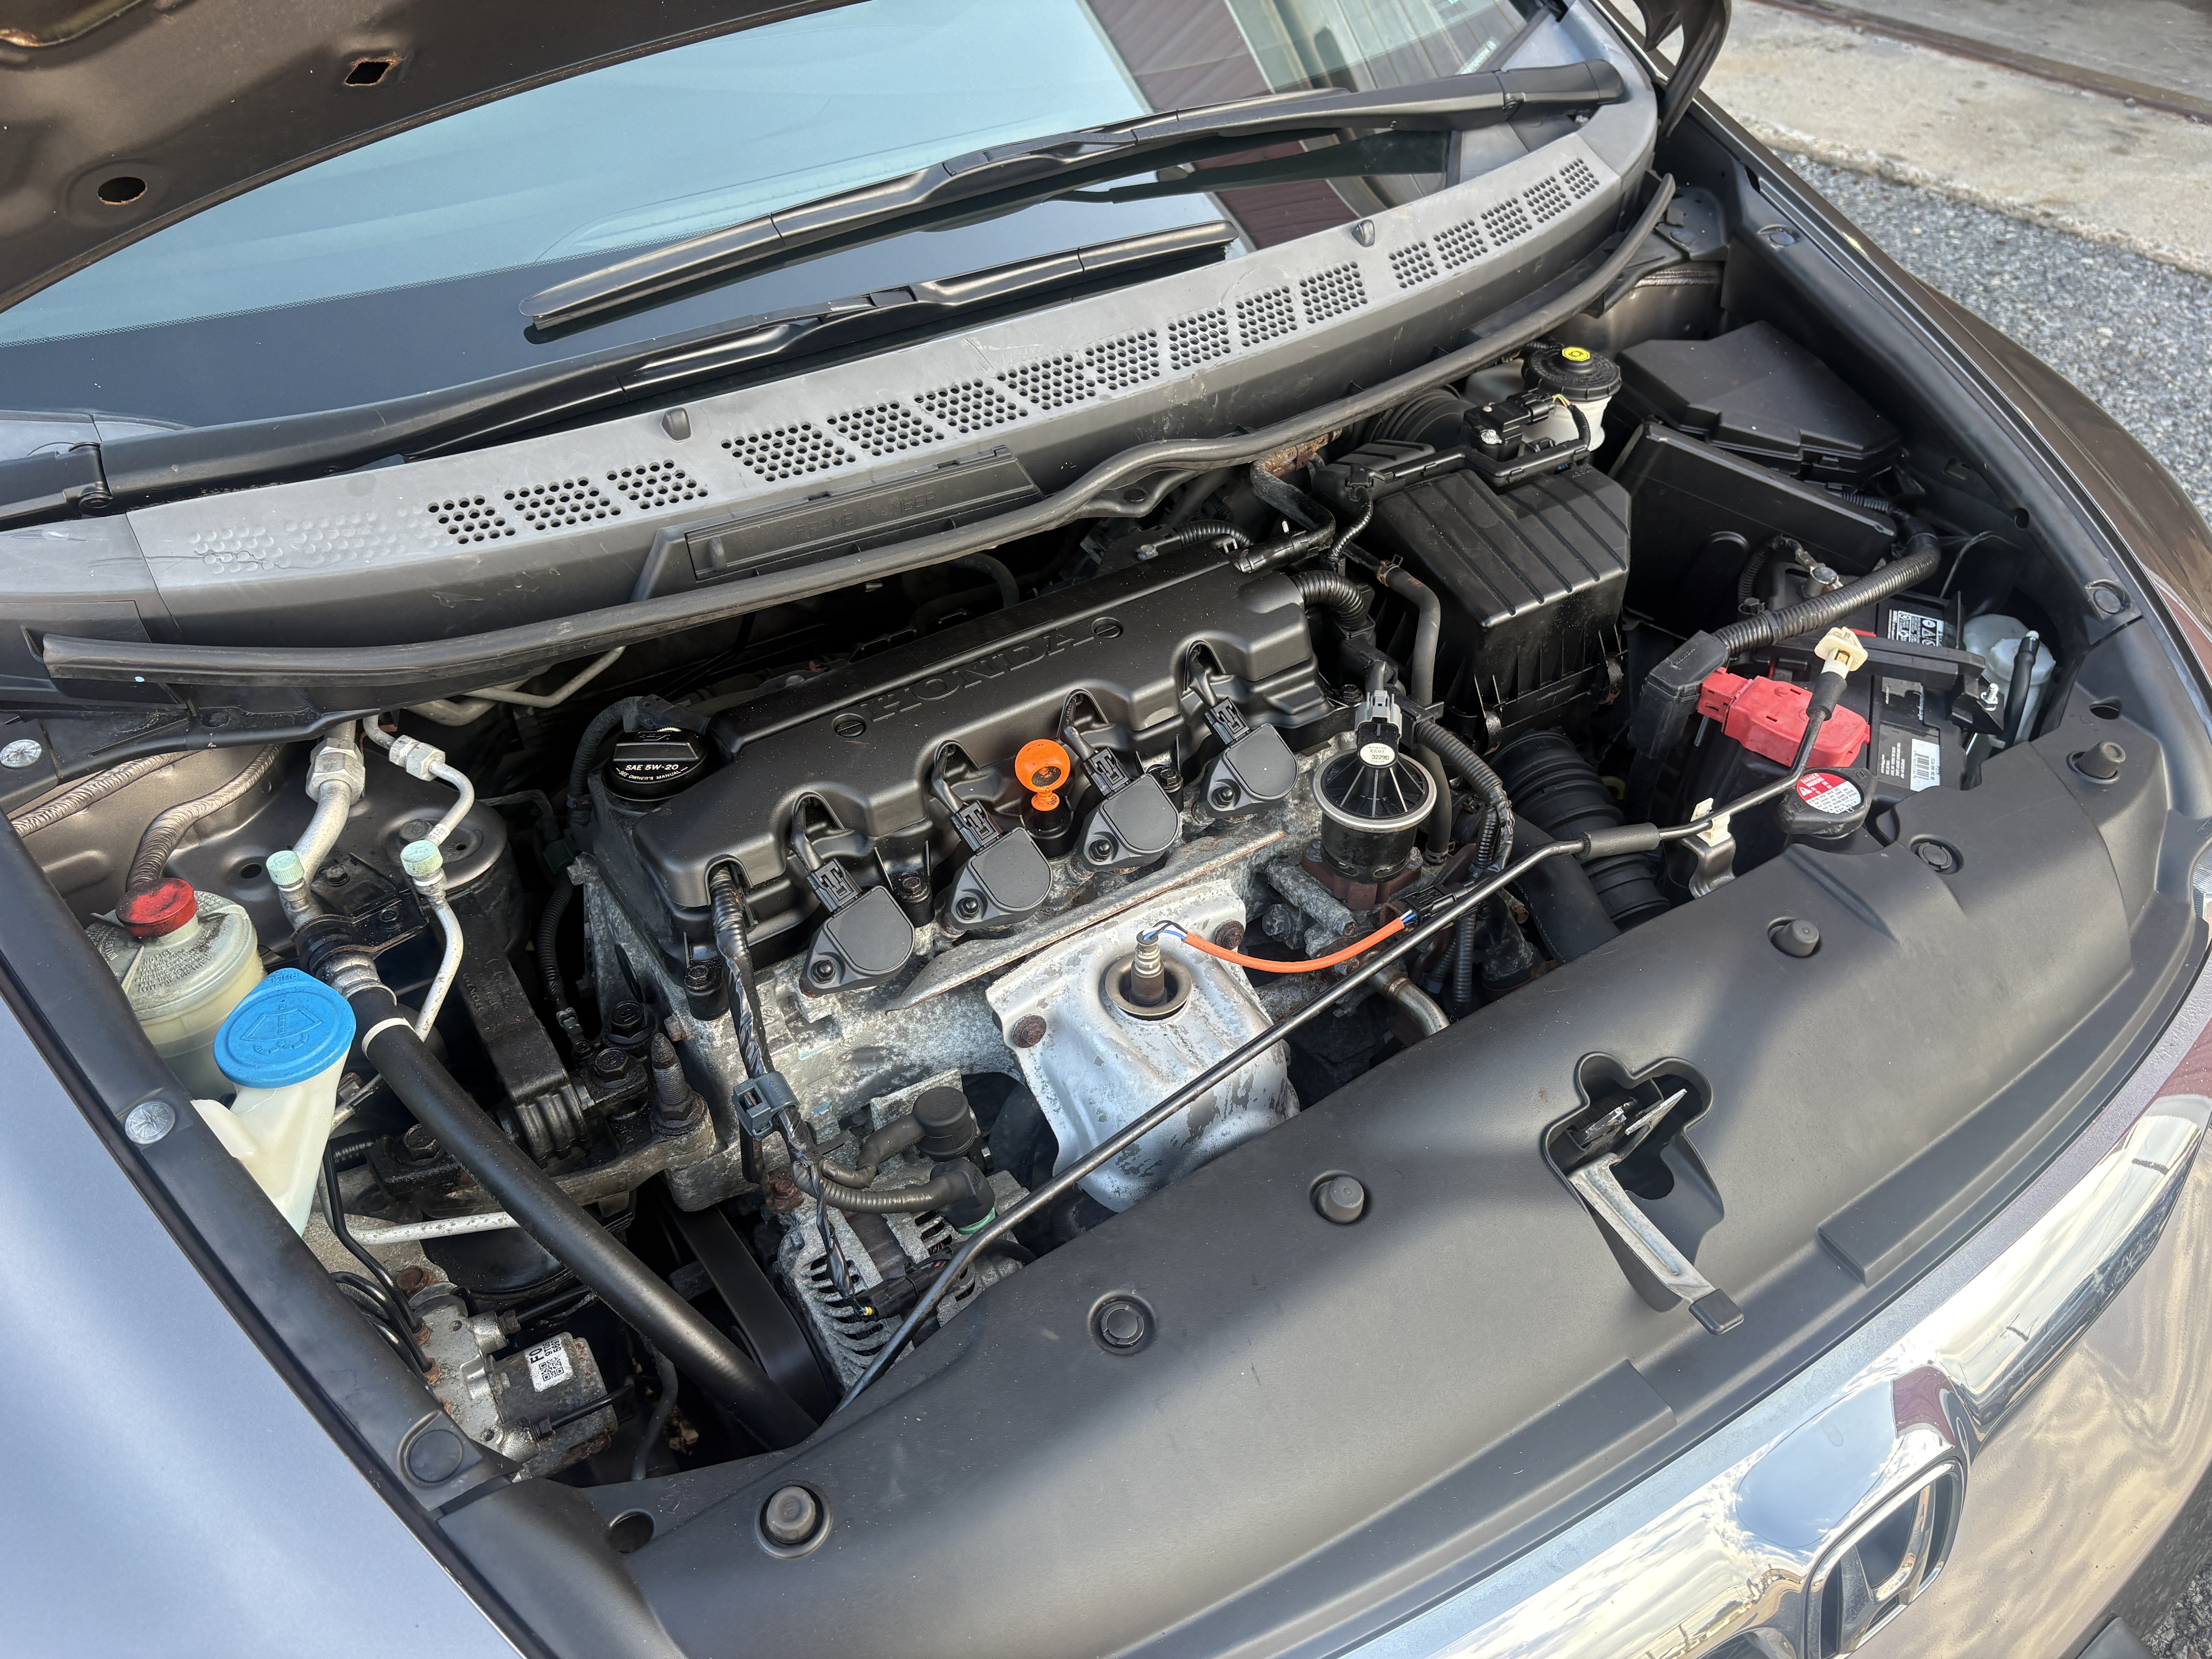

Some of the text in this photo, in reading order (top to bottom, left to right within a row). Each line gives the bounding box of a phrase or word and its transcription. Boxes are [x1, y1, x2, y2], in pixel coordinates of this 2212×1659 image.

[796, 511, 854, 533] FRAME
[860, 632, 1094, 722] HONDA
[656, 770, 682, 780] MANUAL
[144, 949, 174, 964] NOTICE
[268, 972, 298, 983] PULL
